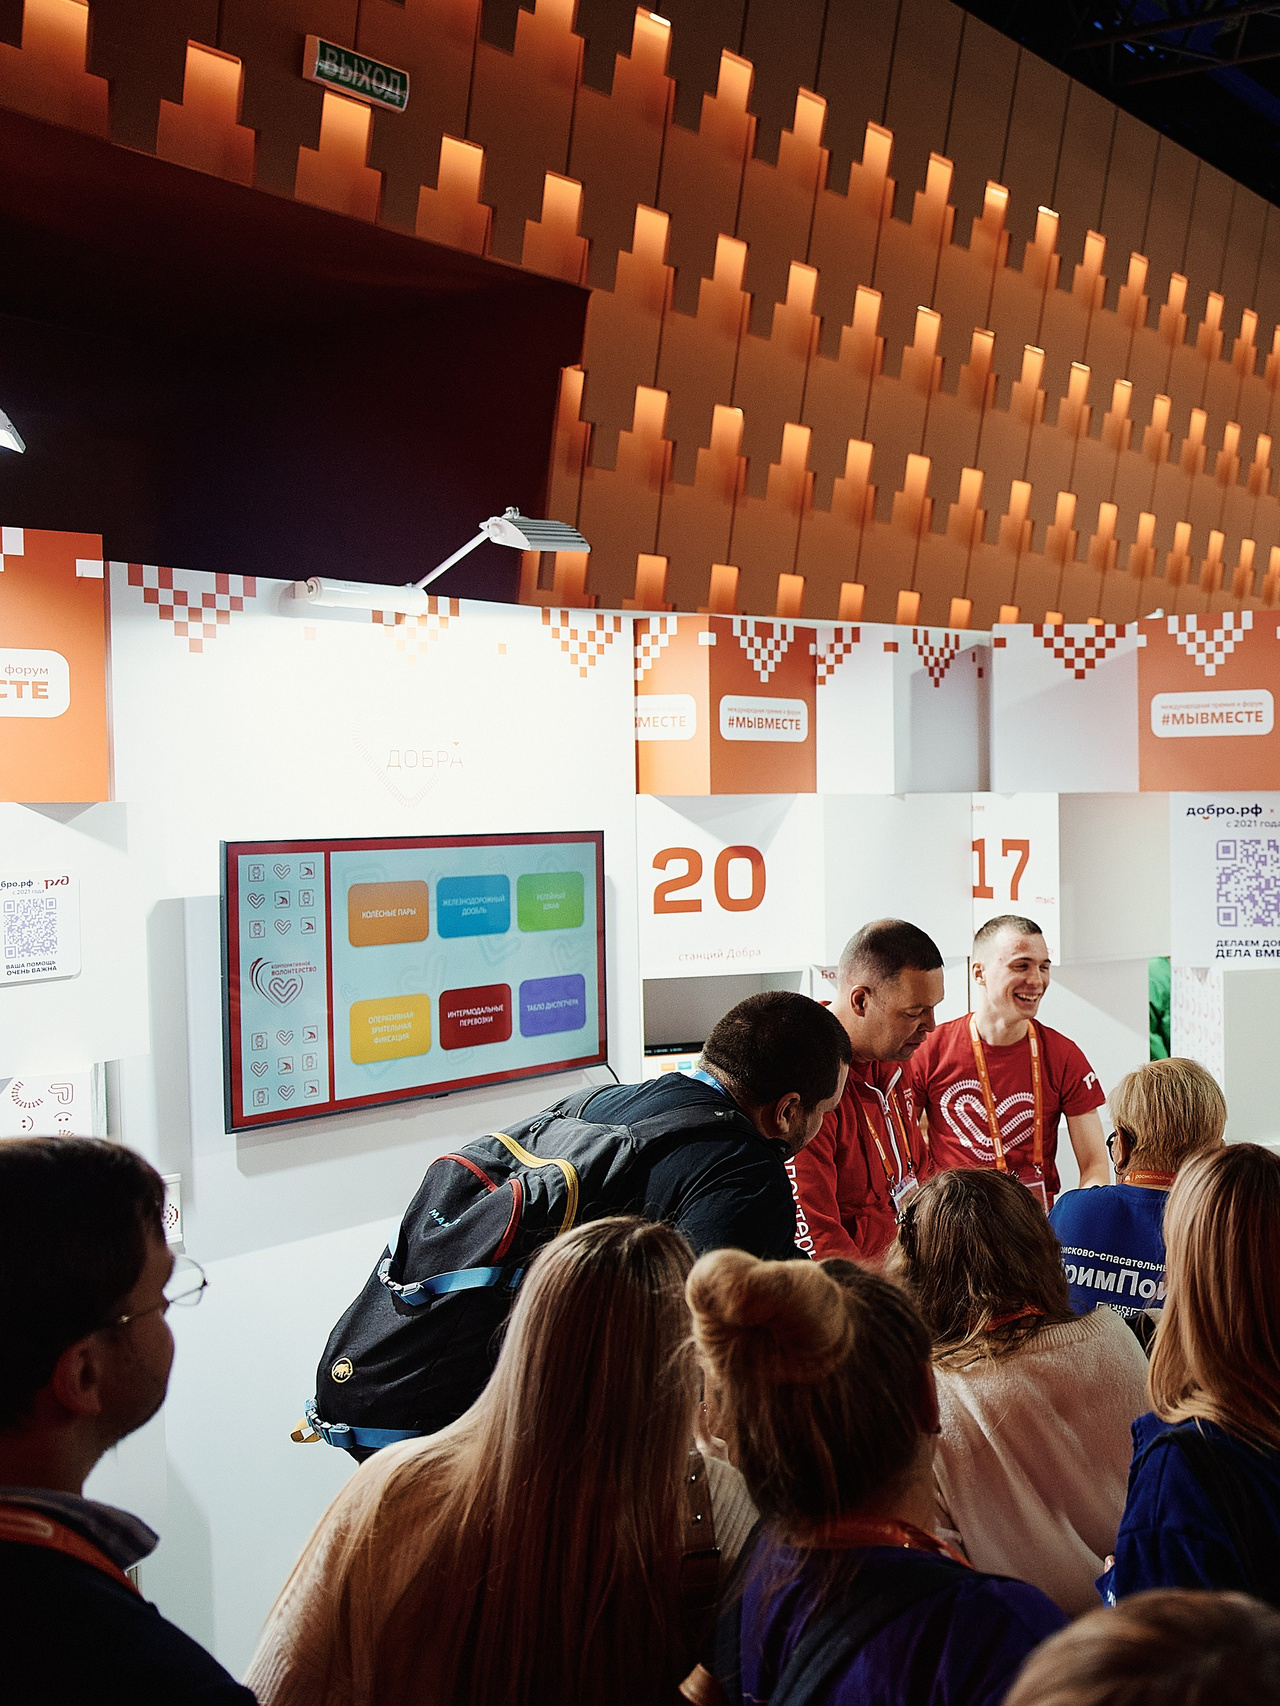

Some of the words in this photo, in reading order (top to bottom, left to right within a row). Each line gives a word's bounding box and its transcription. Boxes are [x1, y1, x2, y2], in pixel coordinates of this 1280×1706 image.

[324, 47, 402, 104] ВЫХОД
[4, 664, 49, 677] форум
[728, 716, 801, 731] #МЫВМЕСТЕ
[1161, 710, 1264, 726] #МЫВМЕСТЕ
[1186, 803, 1263, 819] добро.рф
[1234, 820, 1257, 828] 2021
[652, 845, 766, 915] 20
[397, 907, 416, 917] ПАРЫ
[1216, 940, 1259, 948] ДЕЛАЕМ
[678, 949, 723, 961] станций
[726, 947, 761, 959] Добра
[1216, 949, 1252, 958] ДЕЛА
[26, 960, 56, 968] ПОМОЩЬ
[31, 965, 57, 974] ВАЖНА
[271, 966, 317, 976] ВОЛОНТЕРСТВО
[447, 1004, 504, 1018] ИНТЕРМОДАЛЬНЫЕ
[527, 1002, 545, 1012] ТАБЛО
[459, 1016, 493, 1027] ПЕРЕВОЗКИ
